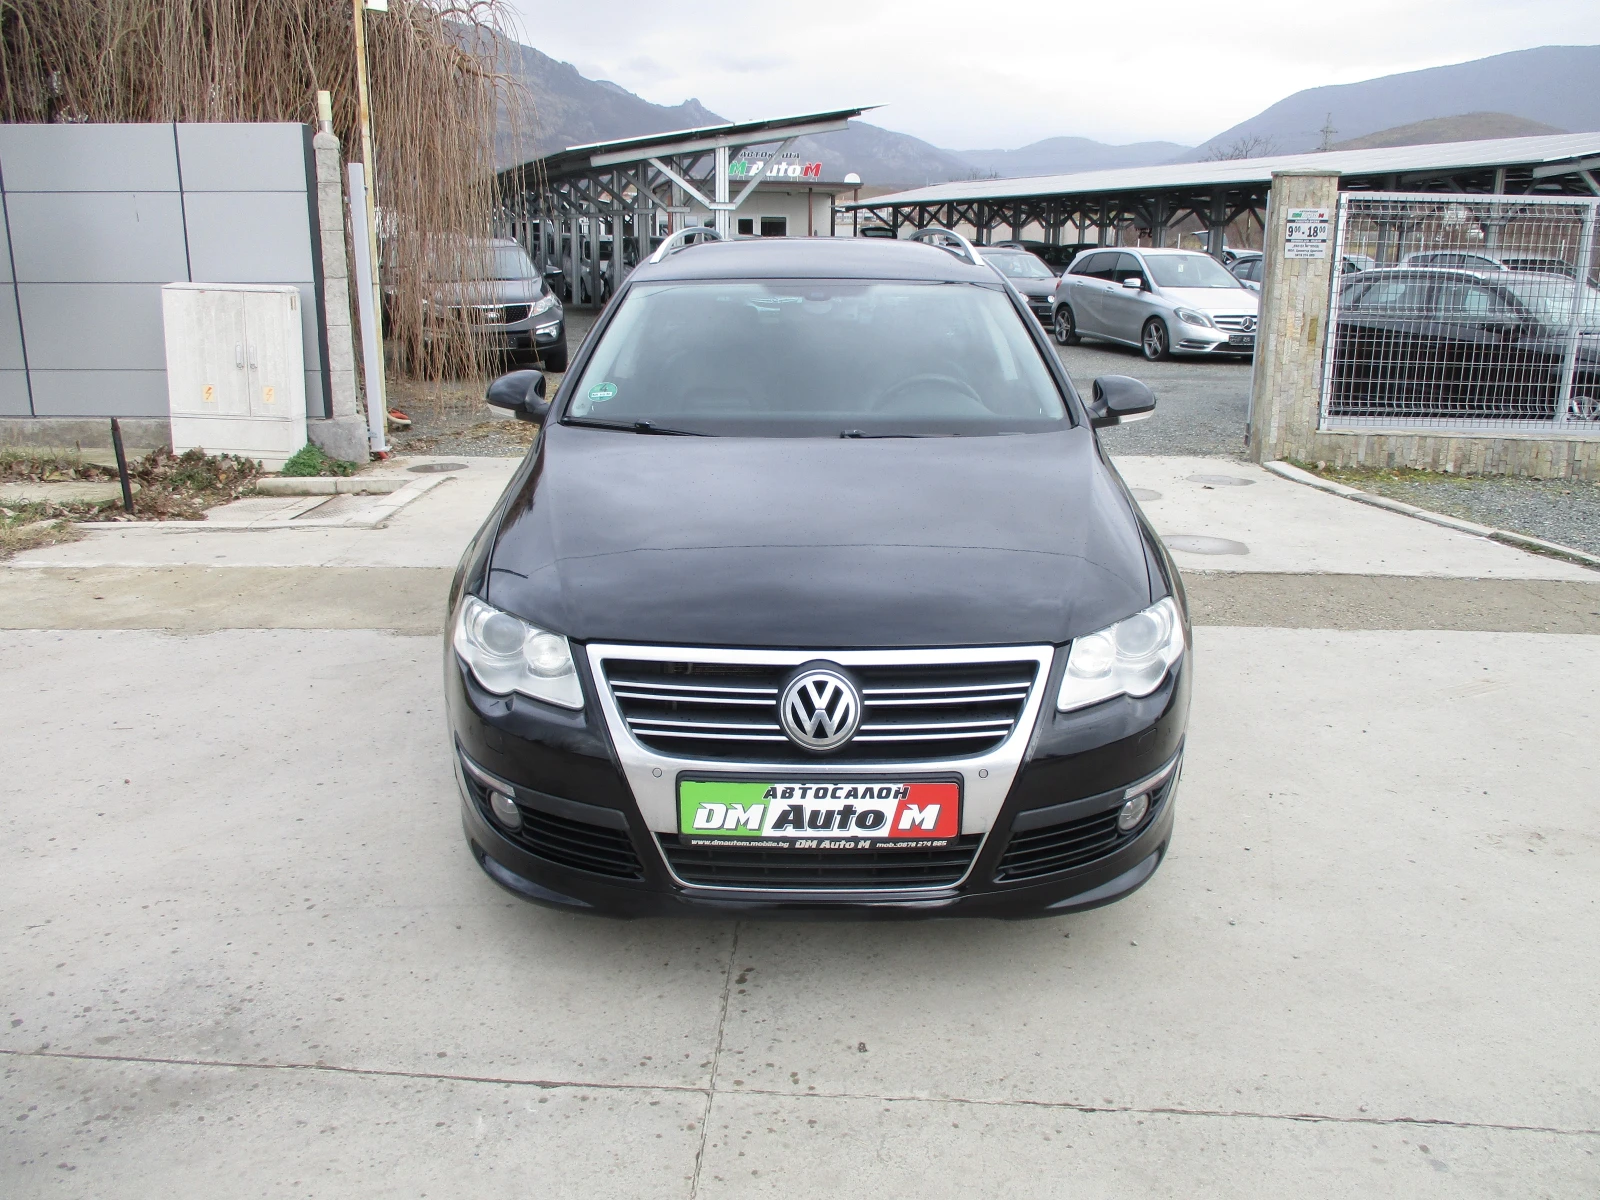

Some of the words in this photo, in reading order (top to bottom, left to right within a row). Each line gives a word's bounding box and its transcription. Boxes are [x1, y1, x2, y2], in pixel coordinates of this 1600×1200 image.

[740, 152, 800, 160] АВТОКЩА
[729, 161, 747, 176] M
[802, 162, 822, 177] M
[781, 669, 860, 751] VW
[762, 786, 910, 800] АВТОСАЛОН
[693, 802, 766, 831] DM
[771, 804, 886, 831] Auto
[897, 803, 941, 831] M
[691, 839, 790, 849] www.dmautom.mobile.bg
[795, 840, 818, 849] DM
[819, 840, 854, 849] Auto
[857, 840, 871, 848] M
